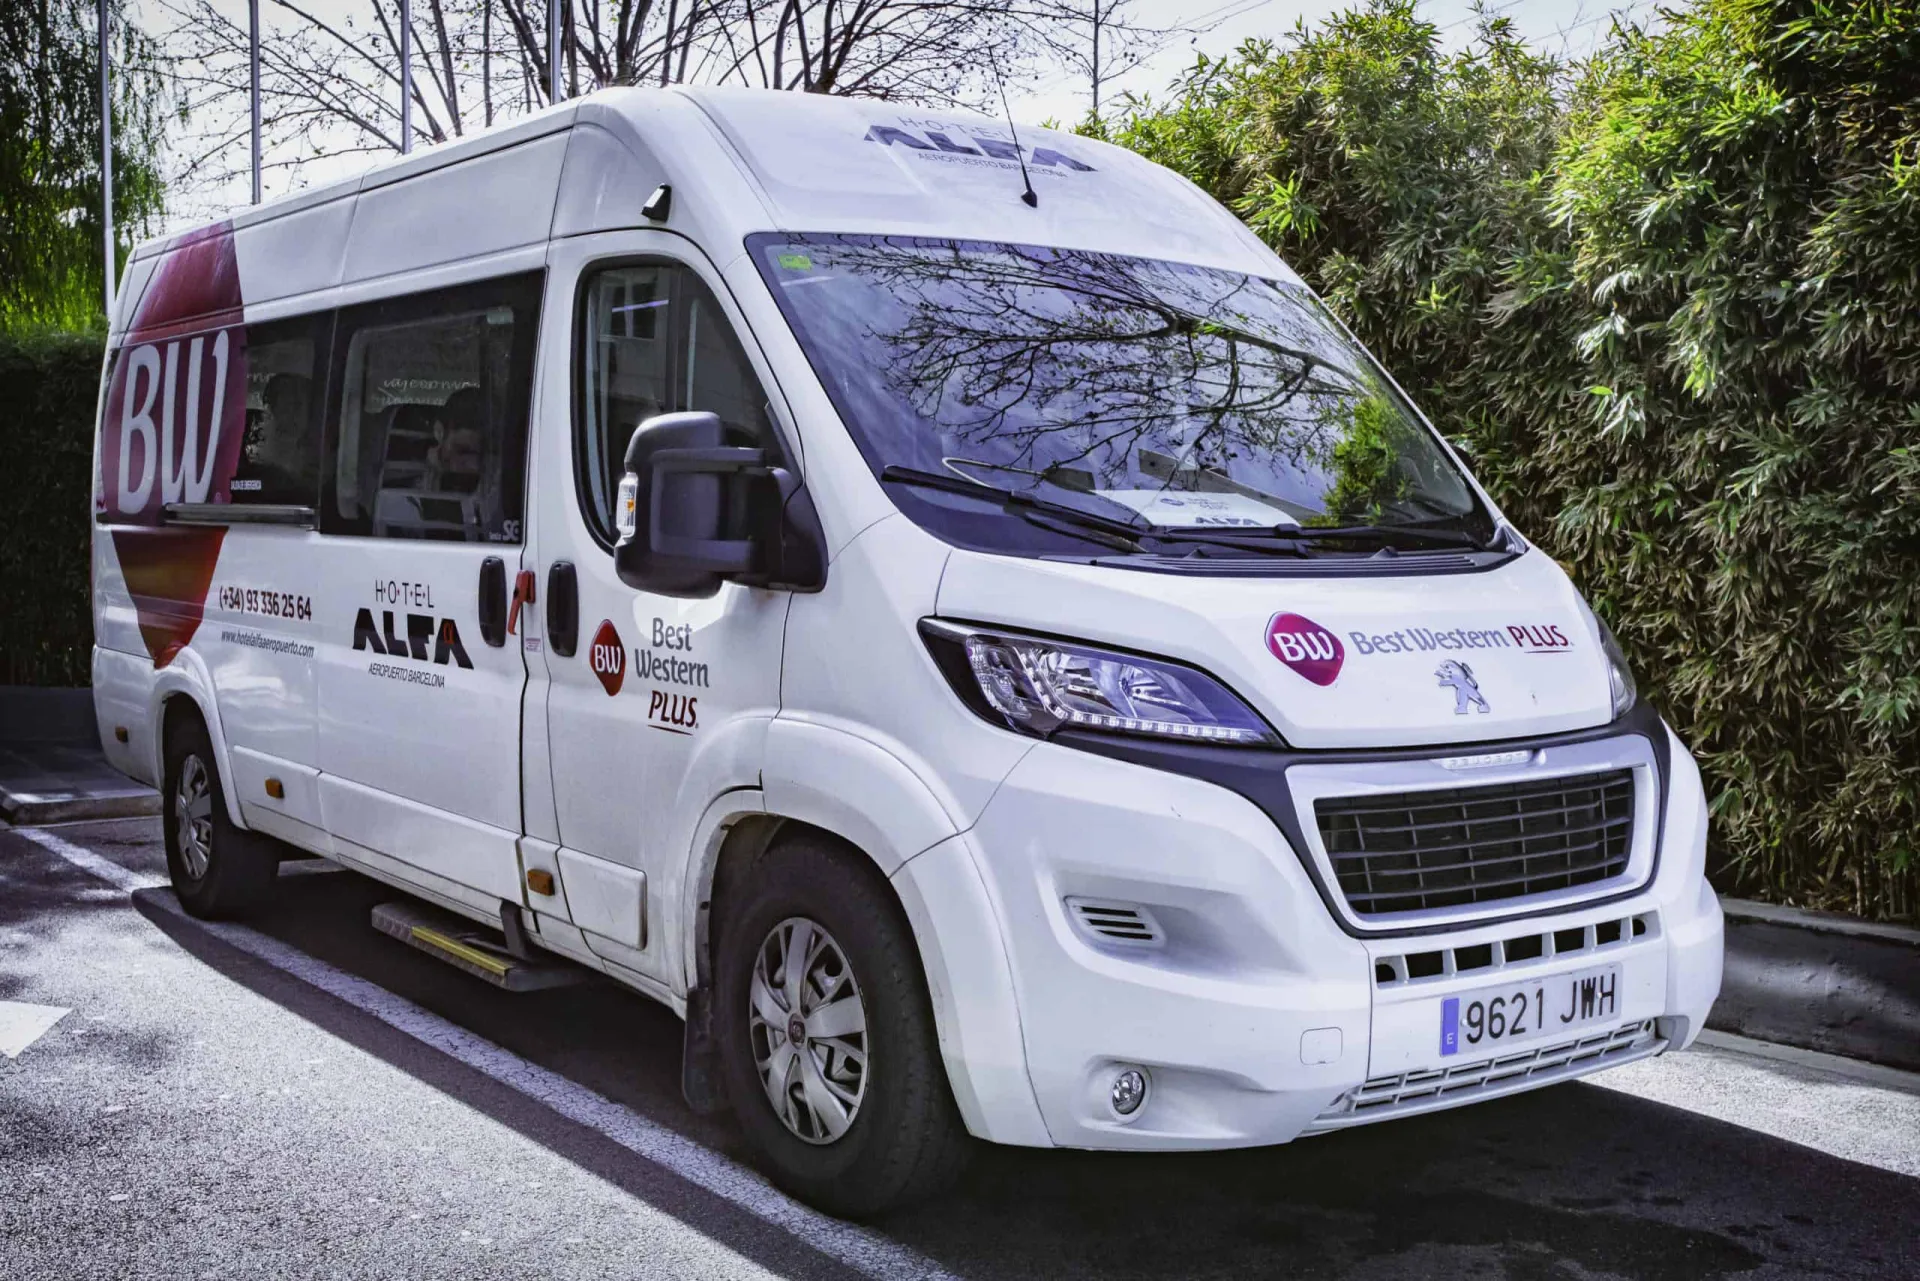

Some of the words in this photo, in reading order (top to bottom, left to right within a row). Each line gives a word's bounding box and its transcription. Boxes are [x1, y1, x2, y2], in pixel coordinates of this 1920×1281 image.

[863, 124, 1099, 172] ALFA
[918, 152, 998, 169] AEROPUERTO
[117, 330, 229, 514] BW
[219, 585, 244, 615] (+34)
[246, 589, 258, 614] 93
[261, 590, 280, 616] 336
[282, 593, 295, 619] 25
[297, 595, 312, 621] 64
[221, 630, 315, 659] www.hotelalfaaeropuerto.com
[353, 607, 475, 670] ALFA
[652, 617, 693, 652] Best
[1273, 630, 1335, 662] BW
[1348, 629, 1415, 656] Best
[1406, 627, 1511, 651] Western
[368, 662, 408, 683] AEROPUERTO
[408, 668, 445, 689] BARCELONA
[594, 643, 621, 675] BW
[634, 647, 710, 688] Western
[1466, 987, 1545, 1045] 9621
[1559, 972, 1616, 1024] JWH
[1446, 1032, 1455, 1045] E
